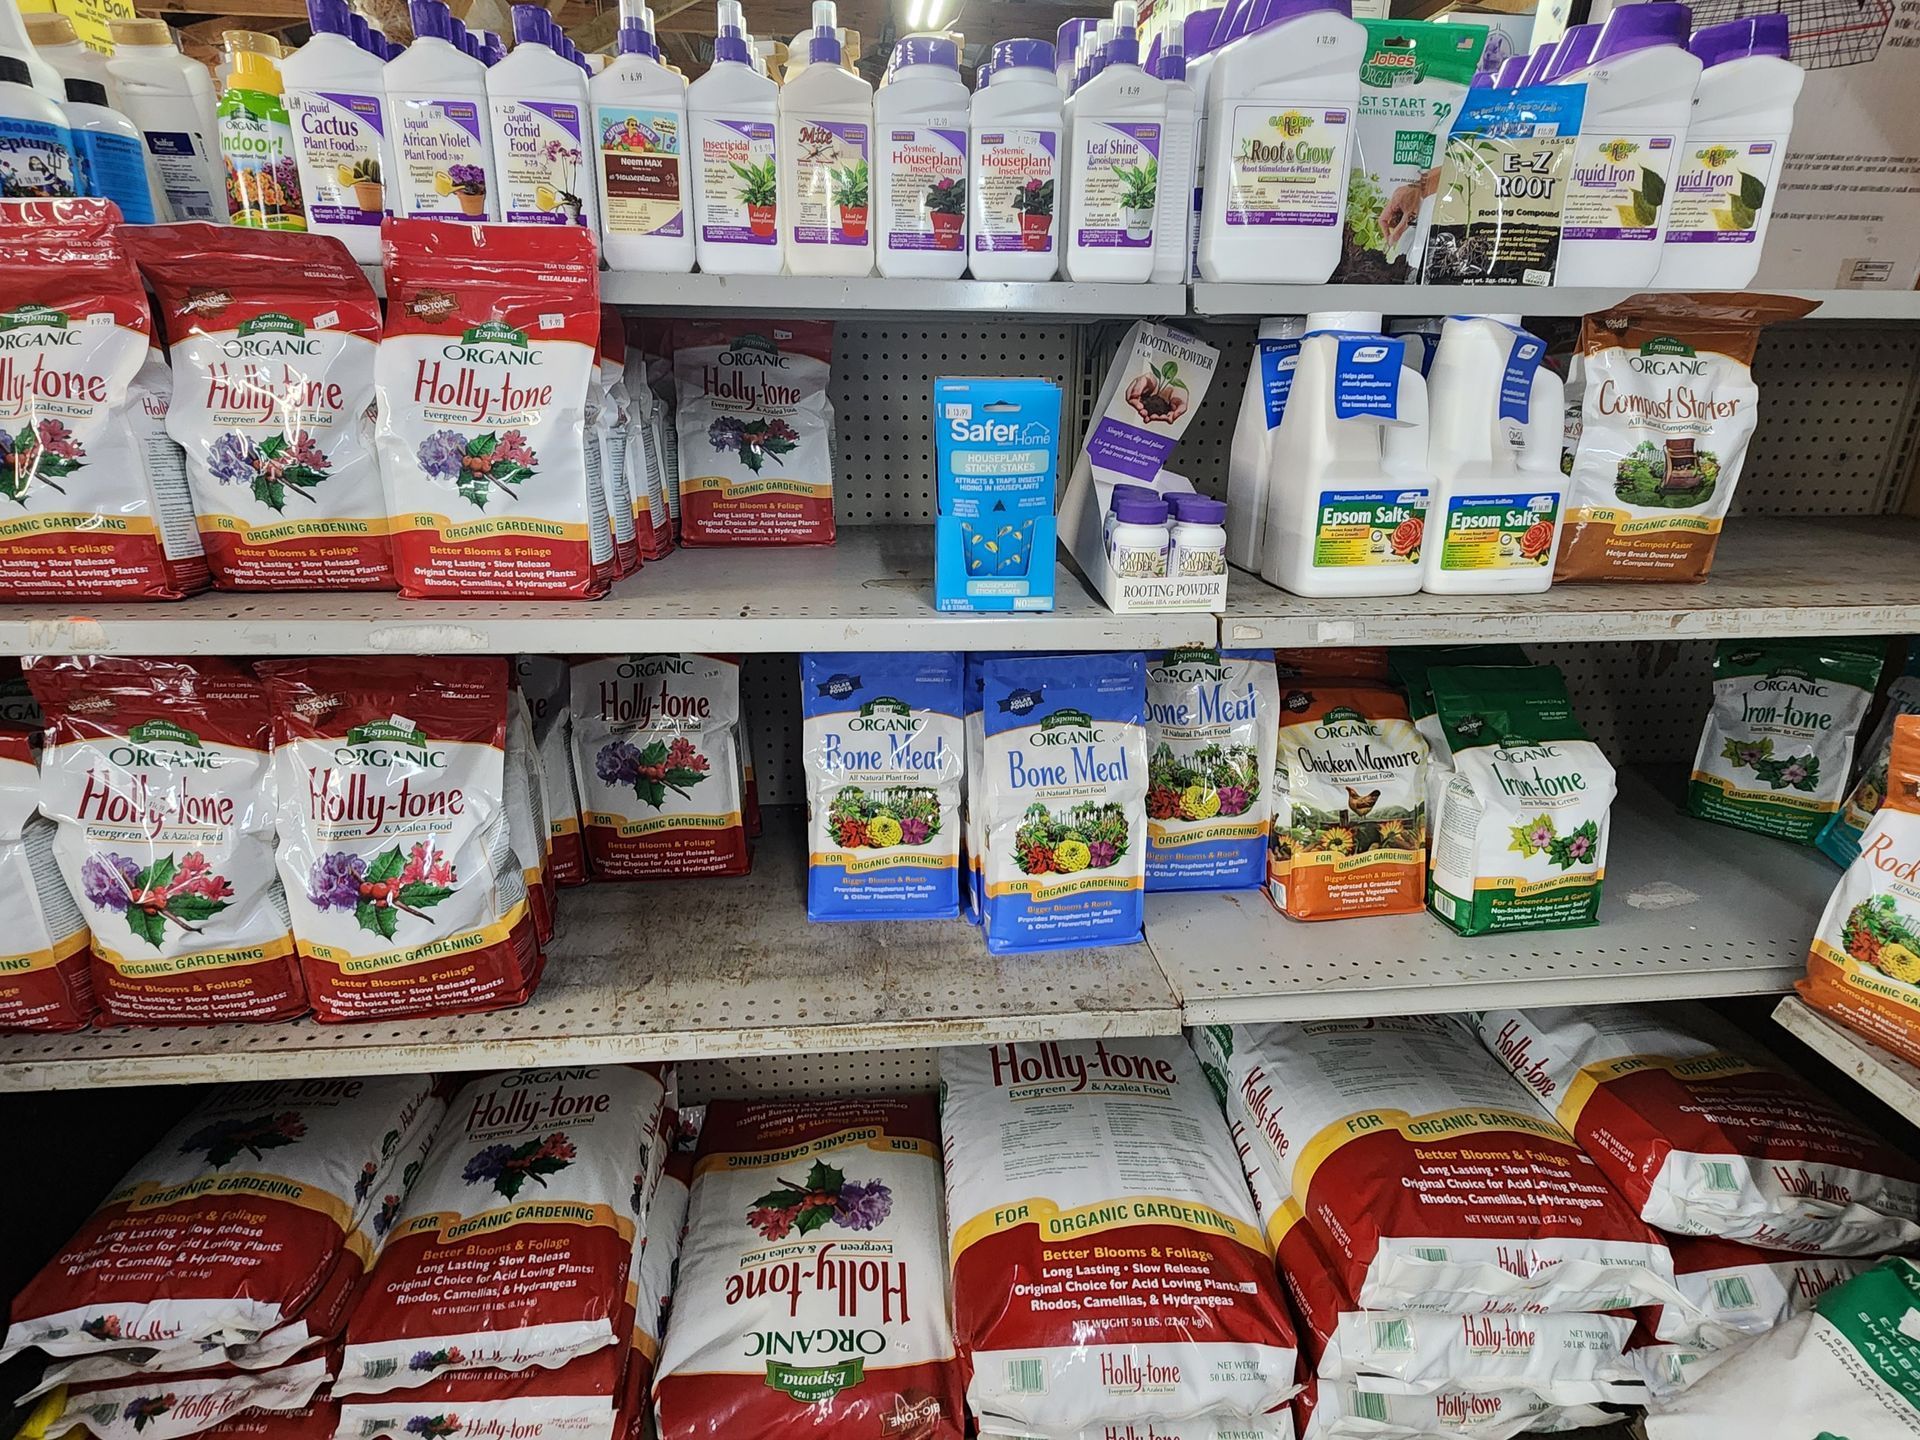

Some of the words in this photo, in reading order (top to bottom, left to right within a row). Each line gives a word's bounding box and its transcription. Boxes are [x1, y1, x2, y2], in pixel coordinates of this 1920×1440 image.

[630, 72, 642, 81] 6.99
[1128, 86, 1140, 96] 8.99
[304, 102, 330, 113] Liquid
[1382, 98, 1426, 108] START
[1389, 108, 1426, 117] TABLETS
[301, 115, 359, 136] Cactus
[404, 118, 428, 129] Liquid
[934, 118, 948, 126] 12.99
[503, 123, 541, 138] Orchid
[798, 126, 832, 144] Mite
[304, 137, 328, 150] Plant
[330, 138, 355, 151] Food
[403, 134, 437, 148] African
[440, 134, 471, 148] Violet
[510, 139, 536, 152] Food
[703, 139, 750, 151] Insecticidal
[1087, 140, 1108, 156] Leaf
[1110, 140, 1138, 156] Shine
[404, 150, 424, 160] Plant
[426, 150, 447, 160] Food
[903, 144, 936, 154] Systemic
[992, 147, 1024, 156] Systemic
[1252, 140, 1284, 162] Root
[1286, 152, 1294, 161] &
[1296, 141, 1336, 162] Grow
[620, 158, 642, 167] Neem
[644, 158, 662, 168] MAX
[728, 151, 748, 163] Soap
[892, 152, 963, 168] Houseplant
[982, 154, 1051, 168] Houseplant
[1121, 157, 1138, 167] guard
[1503, 151, 1553, 174] E-Z
[616, 173, 660, 183] Houseplants
[935, 166, 962, 175] Control
[998, 167, 1021, 175] Insect
[1024, 168, 1051, 176] Control
[1609, 168, 1635, 182] Iron
[1495, 176, 1556, 198] ROOT
[1705, 172, 1733, 187] Iron
[1516, 209, 1559, 218] Compound
[538, 275, 579, 283] RESEALABLE
[414, 299, 451, 314] BIO-TONE
[250, 320, 294, 330] Espoma
[475, 329, 518, 341] Espoma
[223, 340, 321, 358] ORGANIC
[443, 345, 543, 366] ORGANIC
[1139, 331, 1179, 361] ROOTING
[1179, 346, 1214, 371] POWDER
[718, 352, 790, 370] ORGANIC
[1629, 357, 1708, 376] ORGANIC
[414, 359, 552, 423] Holly-tone
[702, 365, 801, 410] Holly-tone
[1600, 380, 1671, 419] Compost
[1677, 385, 1740, 420] Starter
[423, 410, 468, 422] Evergreen
[951, 419, 1019, 442] Safer
[1015, 430, 1050, 445] Home
[968, 453, 1031, 463] HOUSEPLANT
[964, 463, 998, 472] STICKY
[1000, 463, 1036, 471] STAKES
[955, 477, 987, 485] ATTRACTS
[993, 482, 1039, 491] HOUSEPLANTS
[414, 515, 434, 527] FOR
[1323, 507, 1371, 525] Epsom
[1375, 507, 1410, 523] Salts
[1452, 512, 1500, 528] Epsom
[1504, 511, 1540, 527] Salts
[1592, 510, 1615, 520] FOR
[446, 521, 494, 538] ORGANIC
[496, 519, 564, 536] GARDENING
[1621, 519, 1667, 532] ORGANIC
[1669, 519, 1710, 530] GARDENING
[429, 546, 460, 556] Better
[463, 546, 502, 556] Blooms
[505, 547, 512, 556] &
[515, 547, 552, 558] Foliage
[432, 558, 453, 569] Long
[454, 558, 486, 570] Lasting
[493, 559, 513, 568] Slow
[517, 559, 551, 568] Release
[414, 568, 449, 578] Original
[450, 568, 475, 577] Choice
[478, 568, 491, 578] for
[493, 568, 512, 578] Acid
[515, 569, 544, 580] Loving
[546, 569, 577, 578] Plants:
[424, 578, 458, 589] Rhodos,
[460, 579, 504, 589] Camellias,
[506, 579, 513, 588] &
[515, 579, 568, 590] Hydrangeas
[1124, 584, 1174, 598] ROOTING
[1176, 583, 1220, 596] POWDER
[617, 660, 695, 679] ORGANIC
[598, 680, 709, 730] Holly-tone
[1742, 693, 1832, 732] Iron-tone
[1029, 729, 1104, 747] ORGANIC
[1314, 725, 1382, 740] ORGANIC
[825, 733, 882, 771] Bone
[889, 733, 943, 771] Meal
[1008, 750, 1067, 788] Bone
[1071, 746, 1129, 783] Meal
[1298, 747, 1358, 774] Chicken
[1359, 748, 1420, 774] Manure
[1492, 762, 1586, 799] Iron-tone
[1047, 789, 1070, 798] Natural
[1072, 788, 1091, 797] Plant
[1092, 786, 1107, 795] Food
[309, 767, 464, 836] Holly-tone
[1862, 831, 1918, 882] Rock
[989, 1042, 1177, 1092] Holly-tone
[1009, 1084, 1066, 1098] Evergreen
[1091, 1082, 1100, 1091] &
[1102, 1083, 1141, 1093] Azalea
[1143, 1085, 1171, 1097] Food
[465, 1084, 608, 1135] Holly-tone
[1772, 1165, 1852, 1204] Holly-tone
[447, 1211, 513, 1238] ORGANIC
[515, 1205, 594, 1221] GARDENING
[995, 1205, 1029, 1226] FOR
[1049, 1205, 1128, 1234] ORGANIC
[1133, 1203, 1237, 1236] GARDENING
[727, 1244, 911, 1325] Holly-tone
[1464, 1314, 1536, 1357] Holly-tone
[746, 1330, 886, 1357] ORGANIC
[1217, 1361, 1233, 1370] NET
[1235, 1361, 1260, 1370] WEIGHT
[1864, 1341, 1898, 1377] AND
[1101, 1351, 1181, 1392] Holly-tone
[783, 1372, 847, 1387] Espoma
